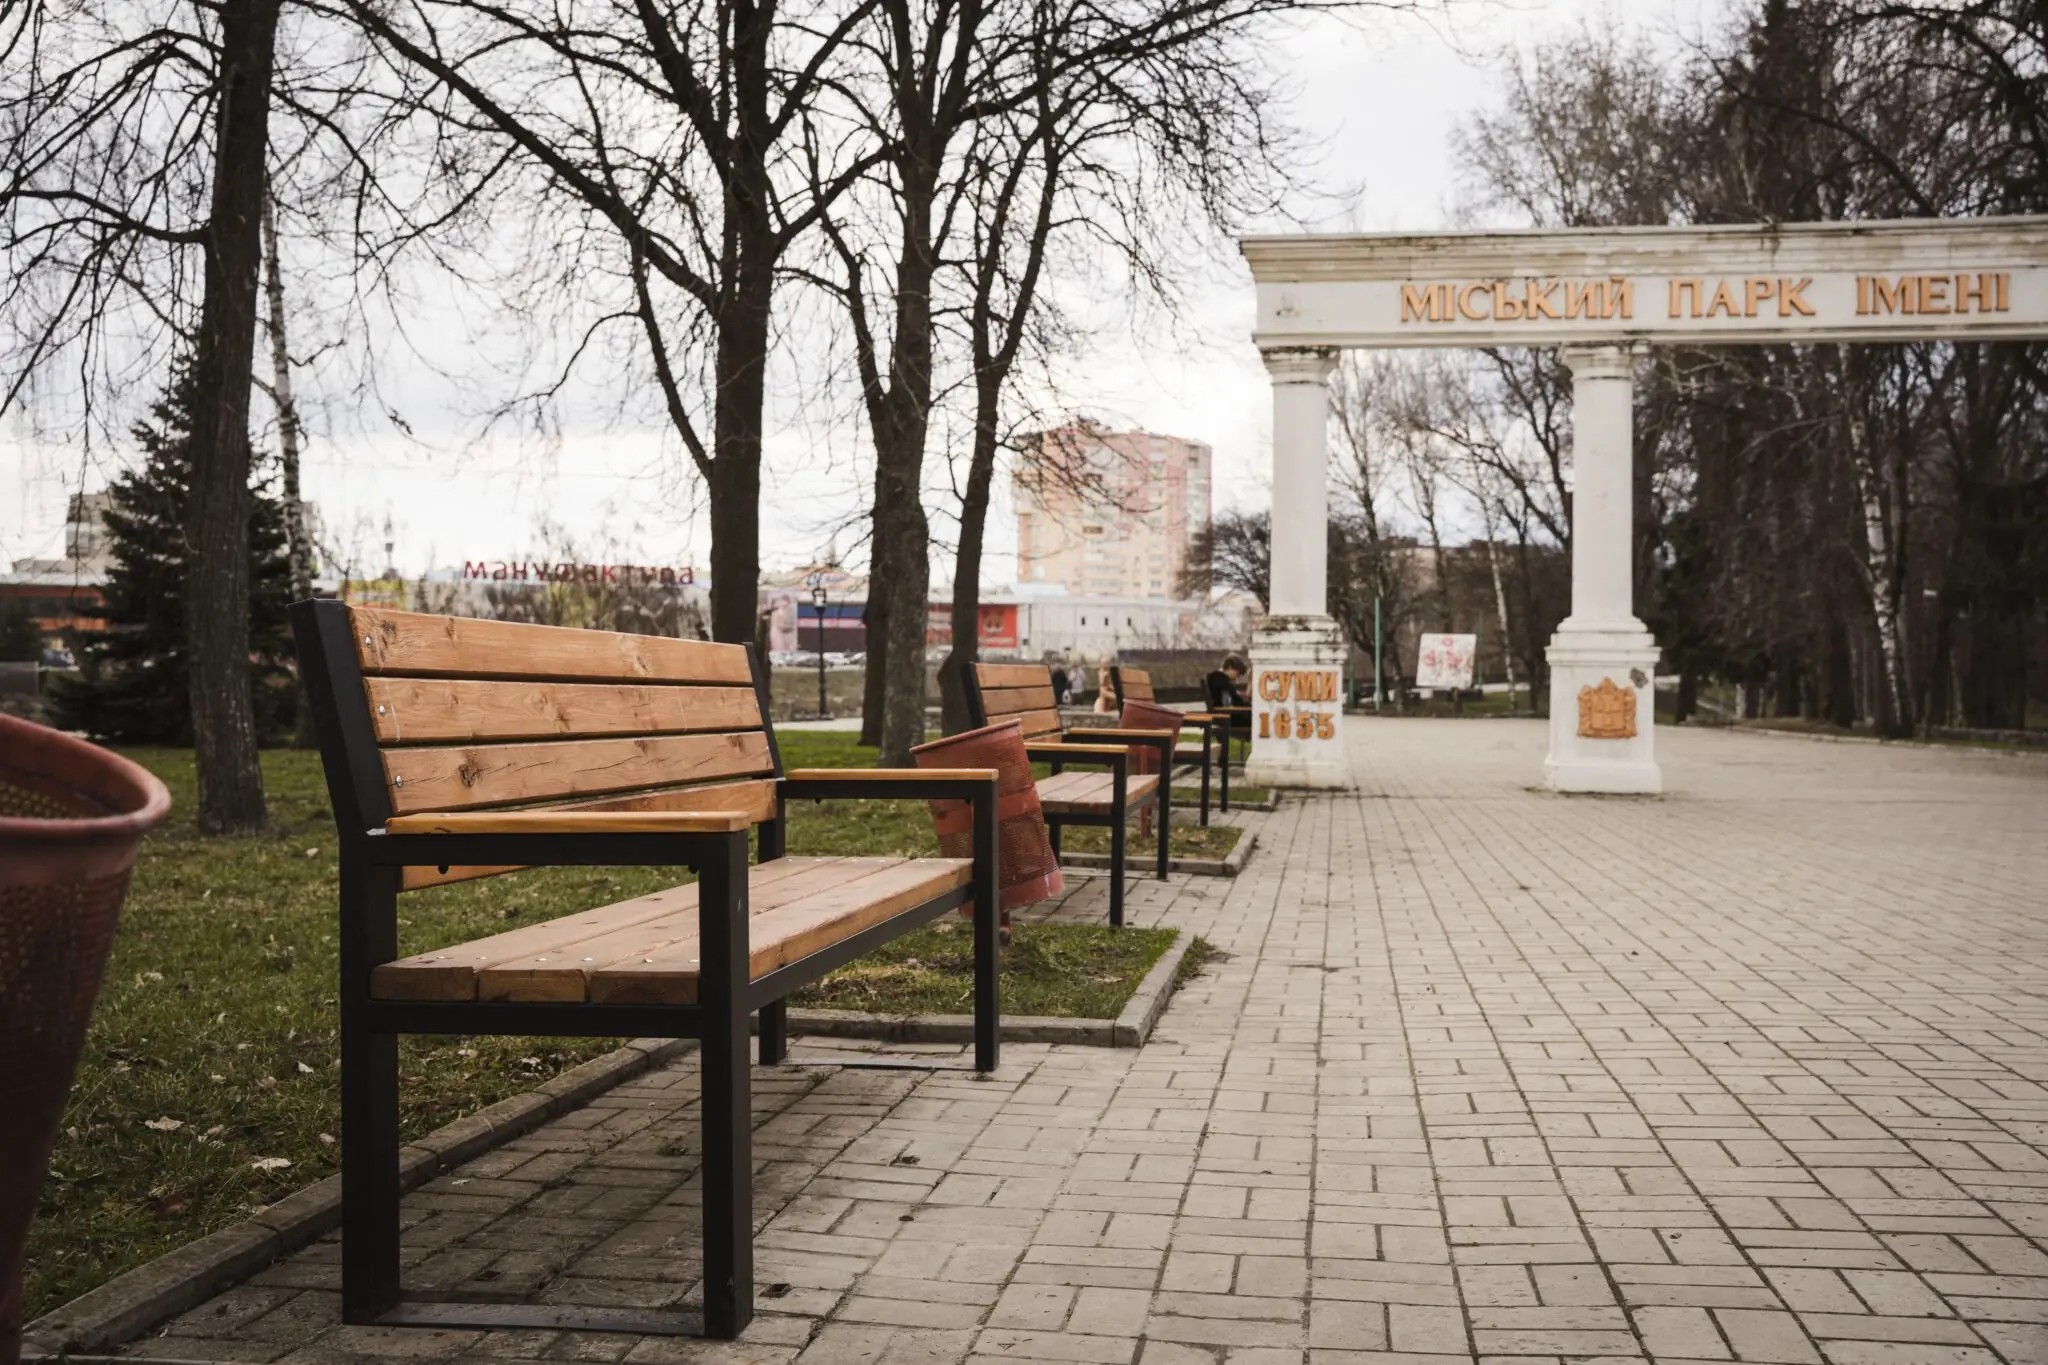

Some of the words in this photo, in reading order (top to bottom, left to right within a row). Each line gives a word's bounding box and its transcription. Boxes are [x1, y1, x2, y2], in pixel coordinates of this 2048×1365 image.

[1400, 275, 1634, 322] МІСЬКИЙ
[1668, 277, 1815, 318] ПАРК
[1856, 273, 2011, 315] ІМЕНІ
[1258, 671, 1338, 702] СУМИ
[1258, 712, 1336, 740] 1655
